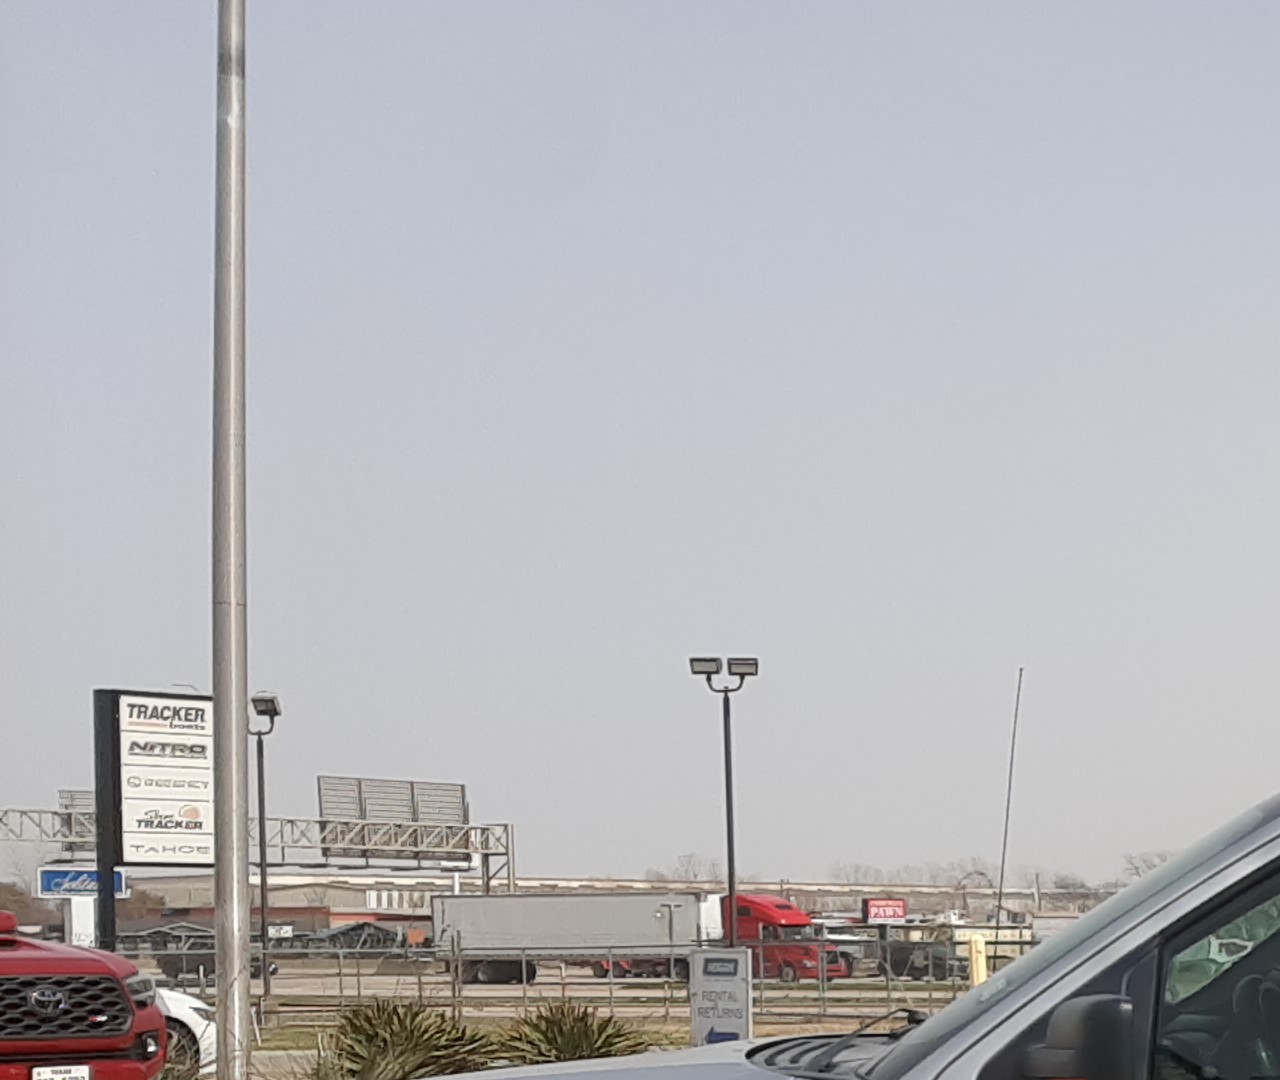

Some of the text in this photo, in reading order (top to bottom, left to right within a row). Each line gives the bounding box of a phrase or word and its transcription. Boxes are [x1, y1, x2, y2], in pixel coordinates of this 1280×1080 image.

[126, 703, 206, 723] TRACKER
[127, 741, 208, 756] NITRO
[135, 818, 204, 831] TRACKER
[129, 844, 211, 855] TAHOE
[870, 906, 905, 918] PAWN
[701, 990, 738, 1003] RENTAL
